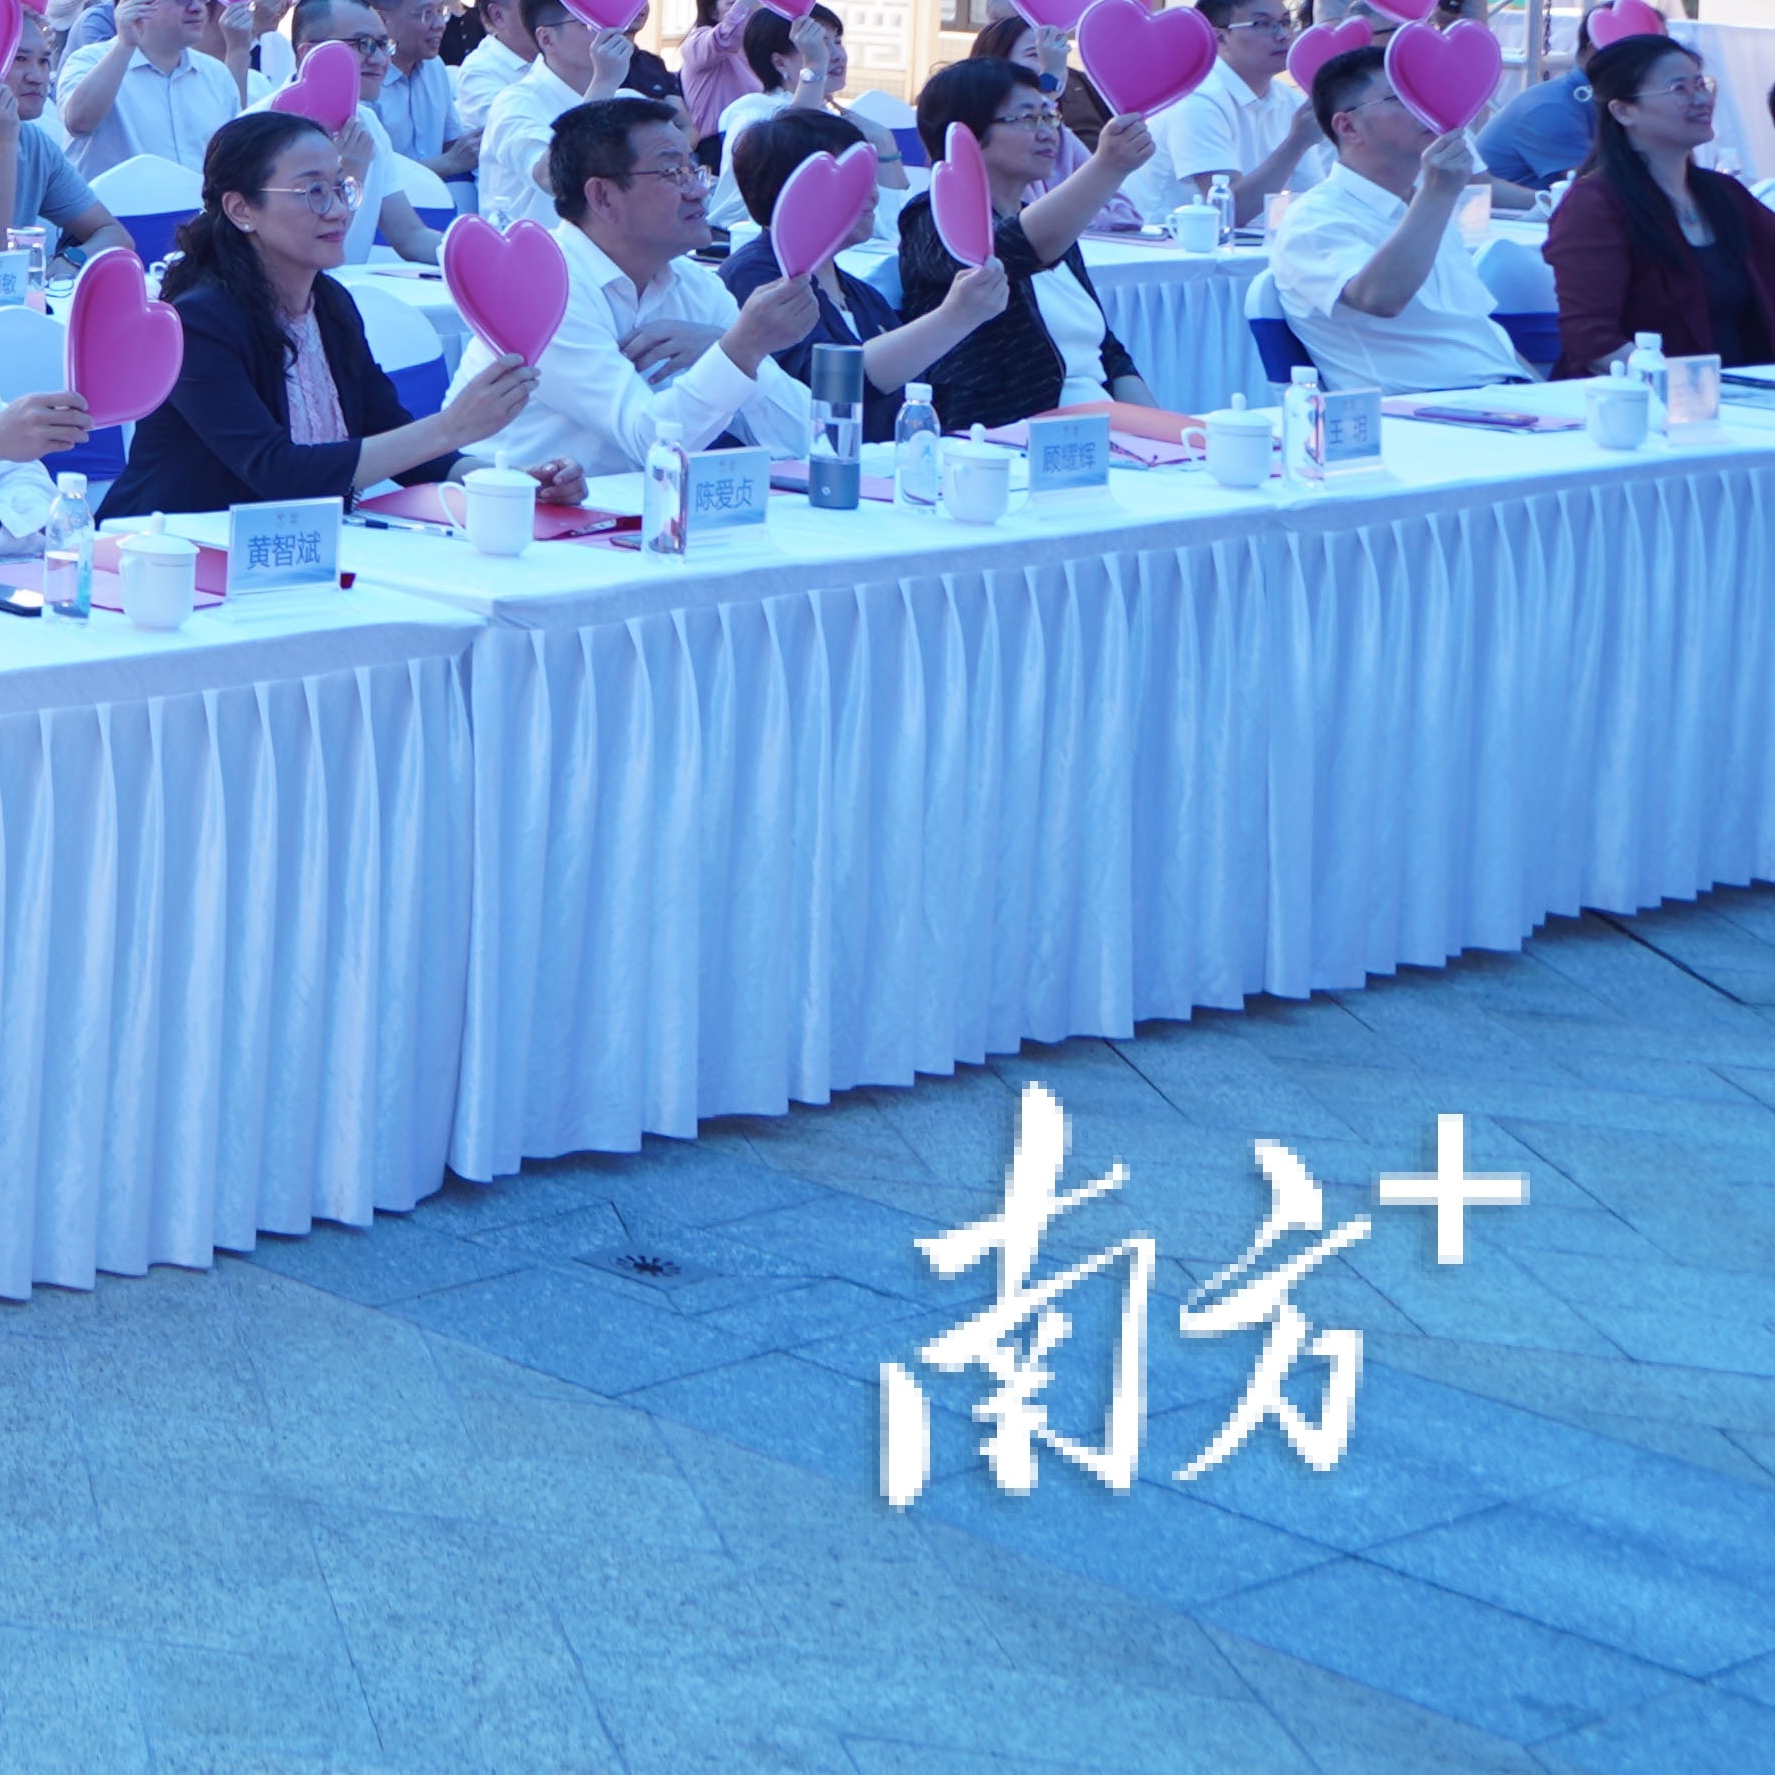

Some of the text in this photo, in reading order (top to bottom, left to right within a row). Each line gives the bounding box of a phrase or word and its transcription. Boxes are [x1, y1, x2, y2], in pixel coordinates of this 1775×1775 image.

[695, 478, 754, 513] 陈爱贞
[246, 530, 322, 571] 黄智斌
